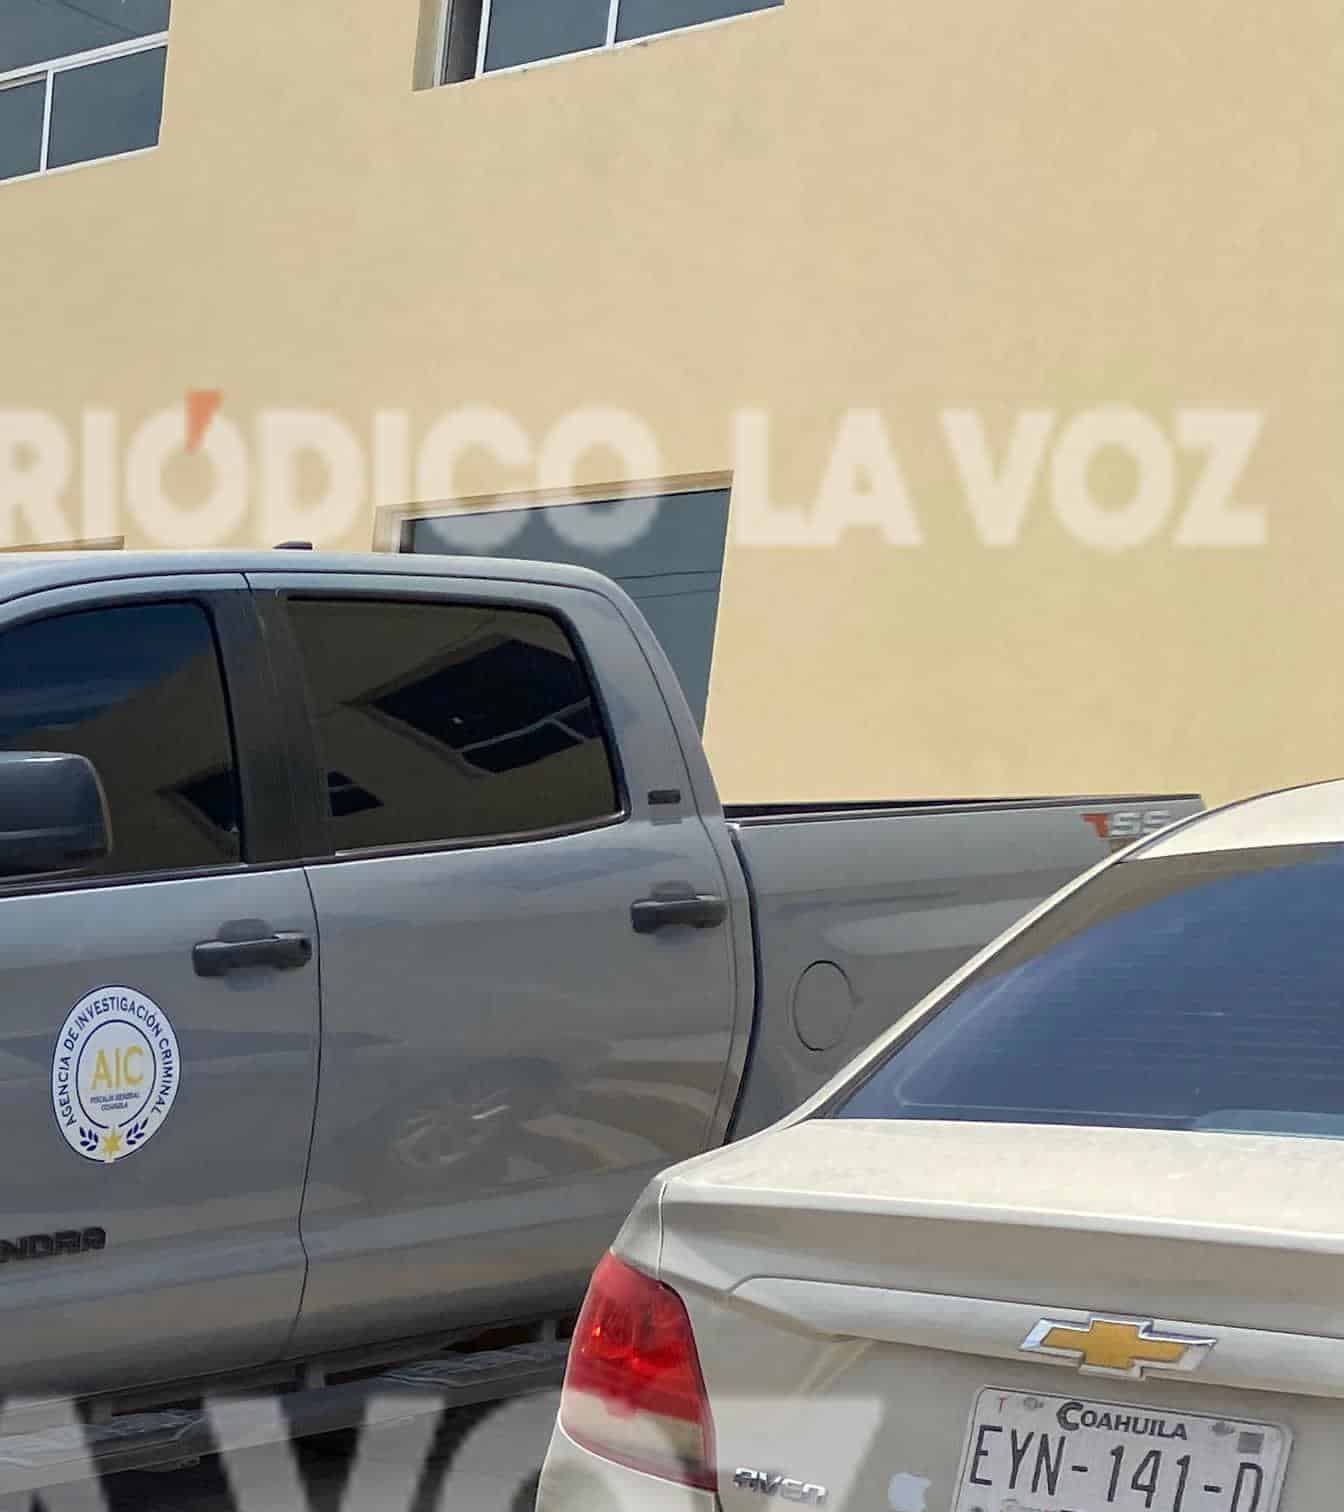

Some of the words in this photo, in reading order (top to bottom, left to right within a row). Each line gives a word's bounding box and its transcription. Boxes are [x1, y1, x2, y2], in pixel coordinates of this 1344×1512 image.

[76, 996, 162, 1037] INVESTIGACIÓN
[63, 1027, 80, 1052] DE
[90, 1046, 145, 1090] AIC
[151, 1037, 173, 1114] CRIMINAL
[57, 1055, 77, 1127] AGENCIA
[1056, 1401, 1189, 1440] COAHUILA
